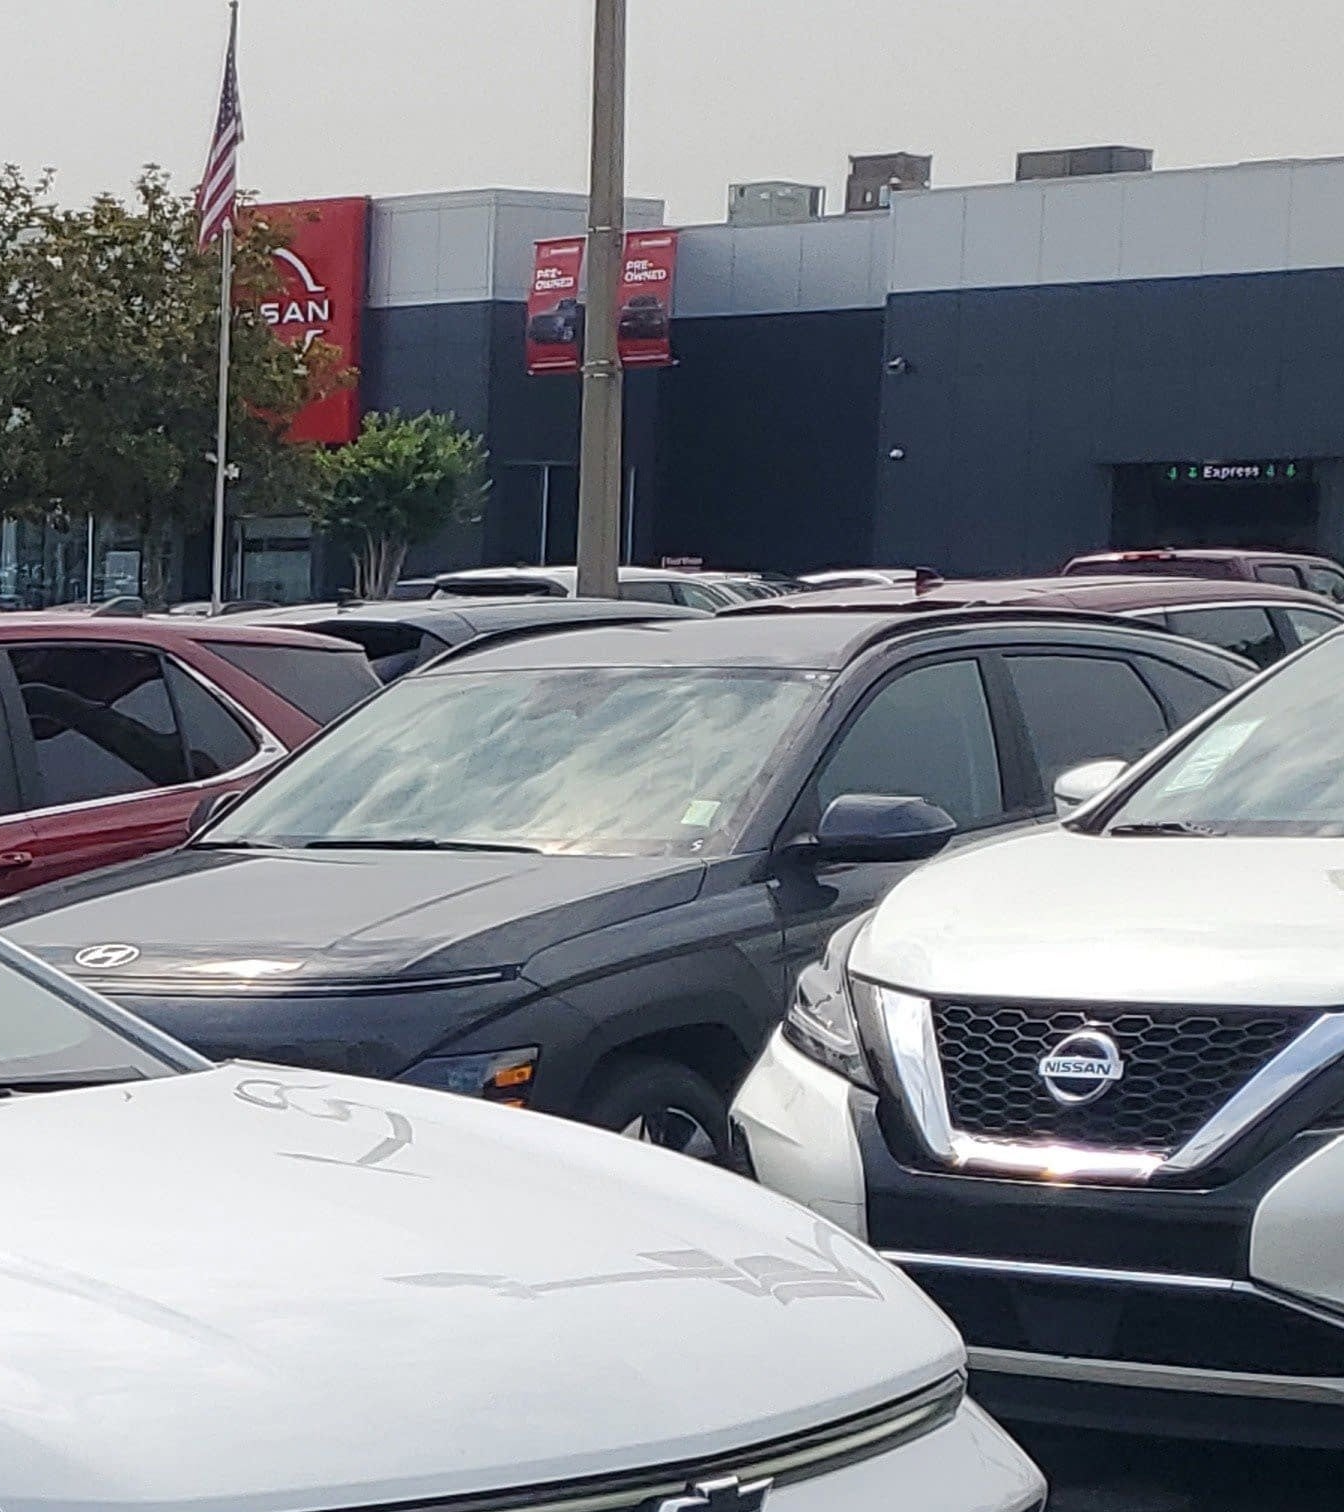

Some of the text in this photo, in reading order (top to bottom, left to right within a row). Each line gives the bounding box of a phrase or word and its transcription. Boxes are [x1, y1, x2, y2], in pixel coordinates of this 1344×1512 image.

[624, 269, 667, 282] OWNED
[234, 299, 329, 324] SAN
[1203, 465, 1260, 479] Express
[1044, 1061, 1112, 1075] NISSAN
